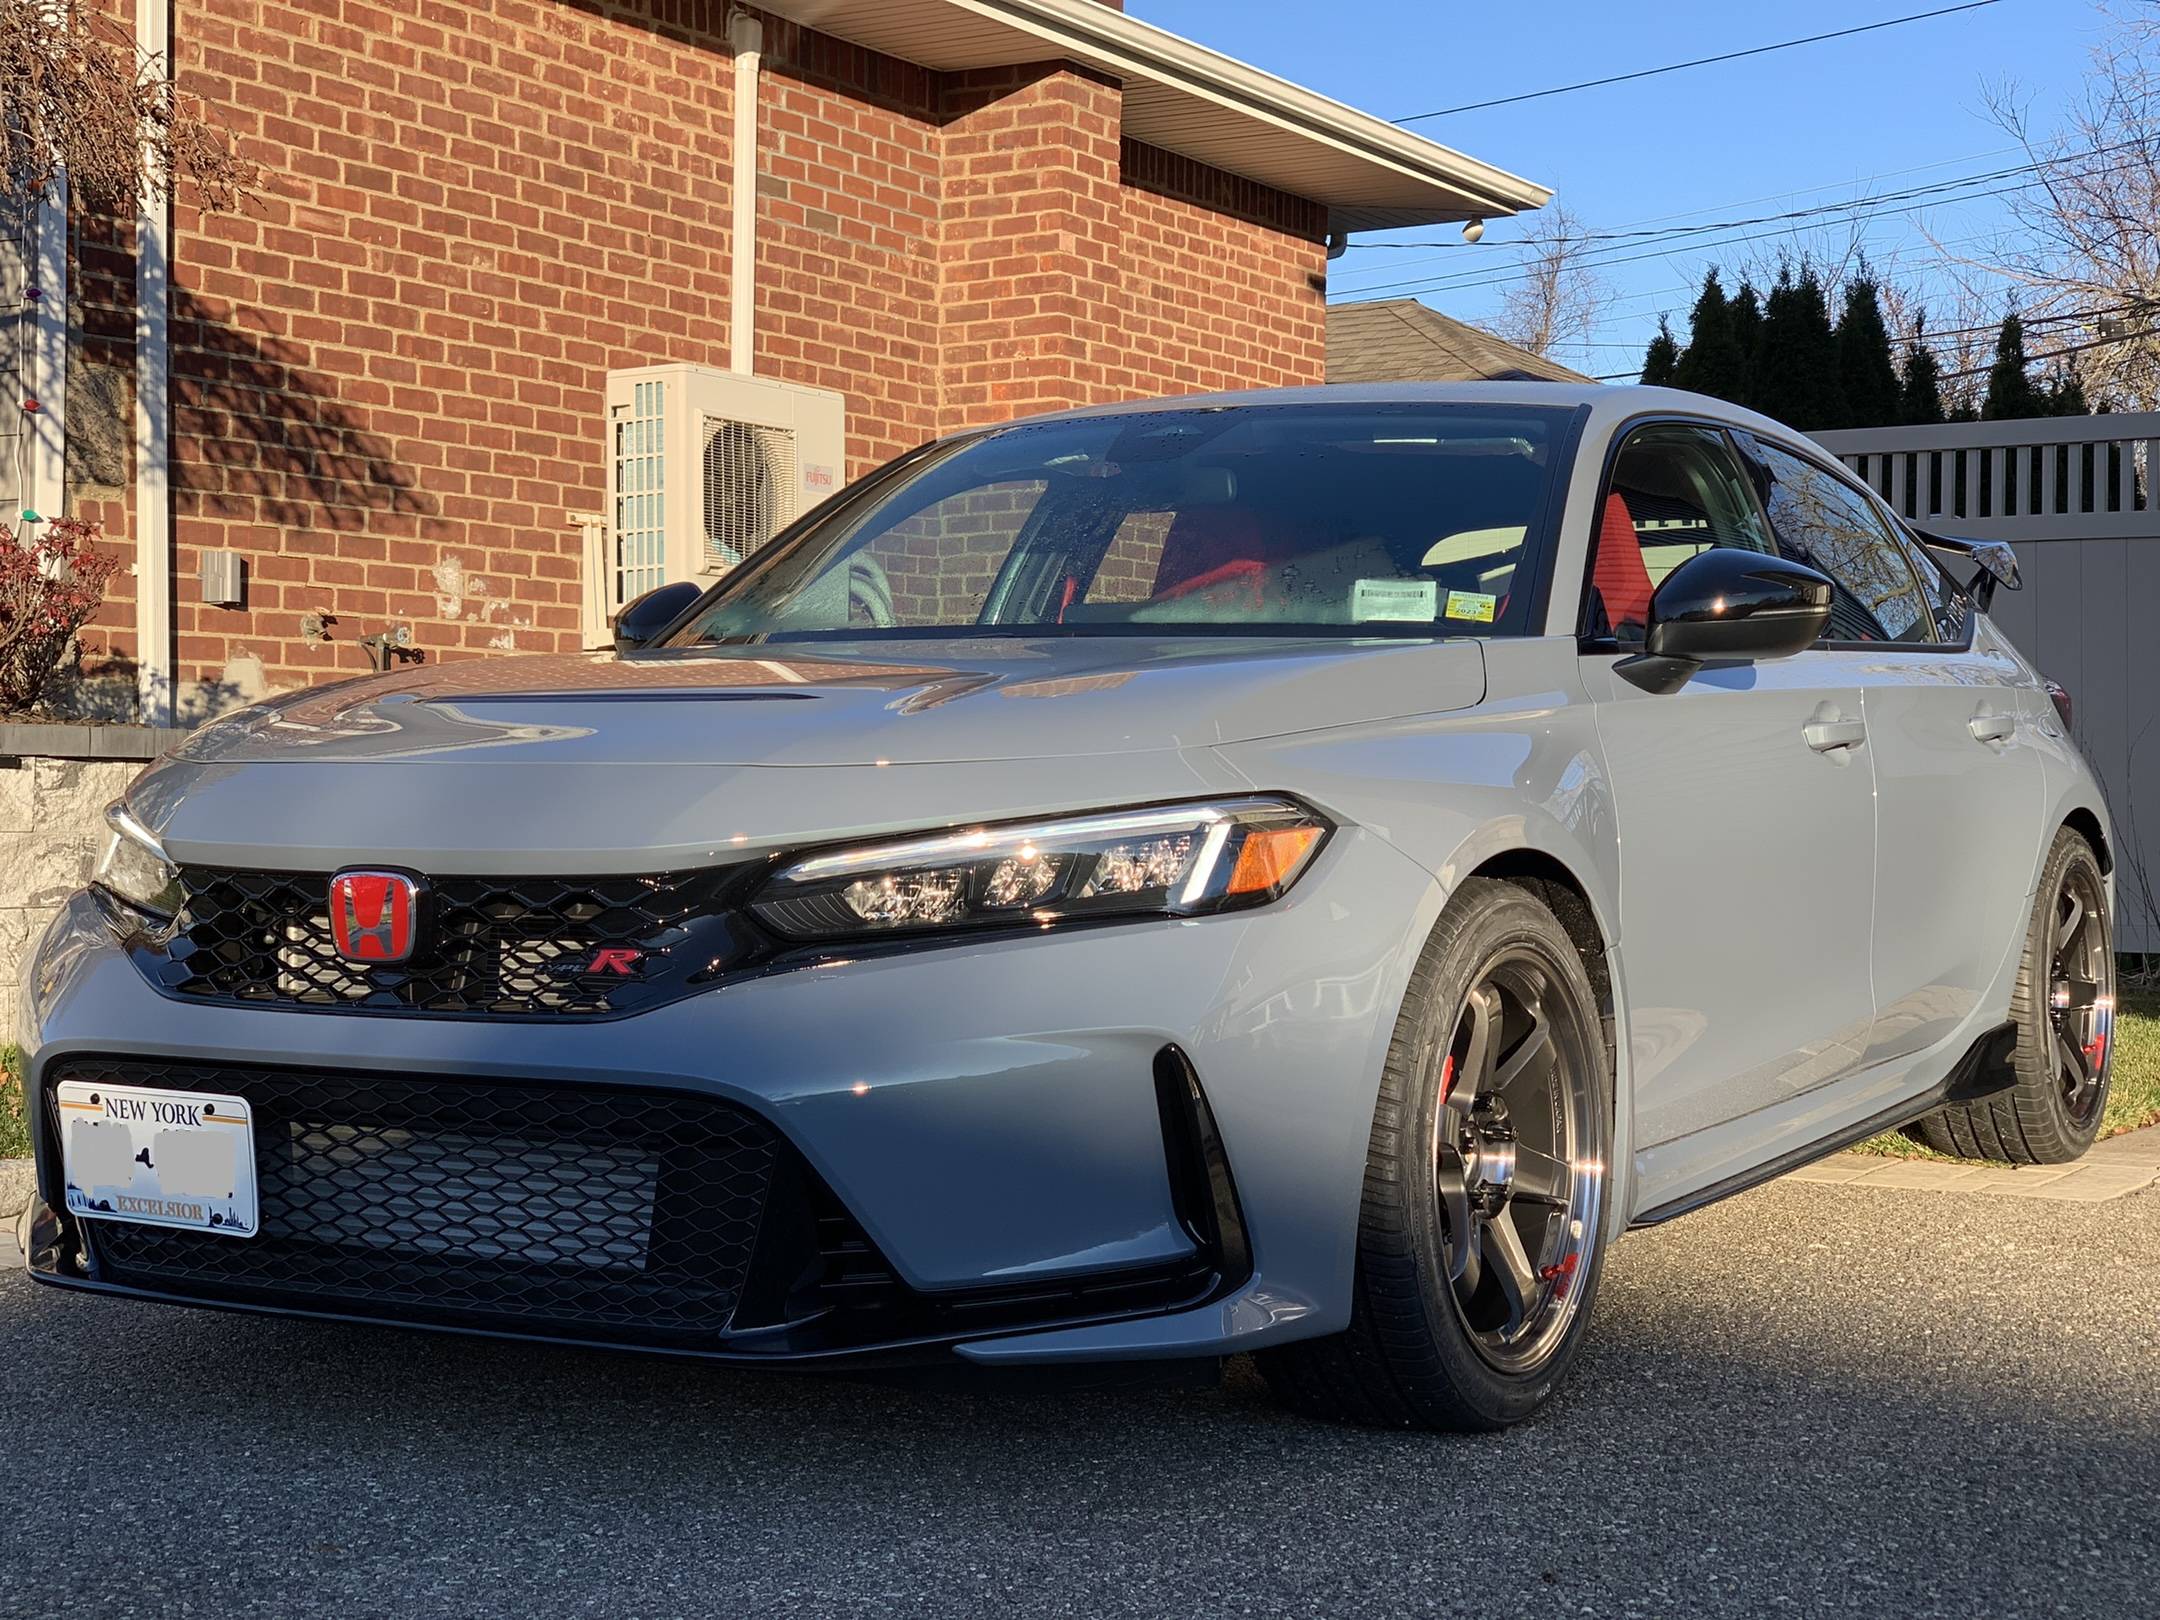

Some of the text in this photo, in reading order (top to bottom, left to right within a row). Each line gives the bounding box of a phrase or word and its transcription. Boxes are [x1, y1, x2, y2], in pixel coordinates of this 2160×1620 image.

[806, 471, 833, 486] FUJITSU
[588, 948, 643, 975] R
[104, 1097, 202, 1127] NEW YORK
[116, 1195, 204, 1221] EXCELSIOR
